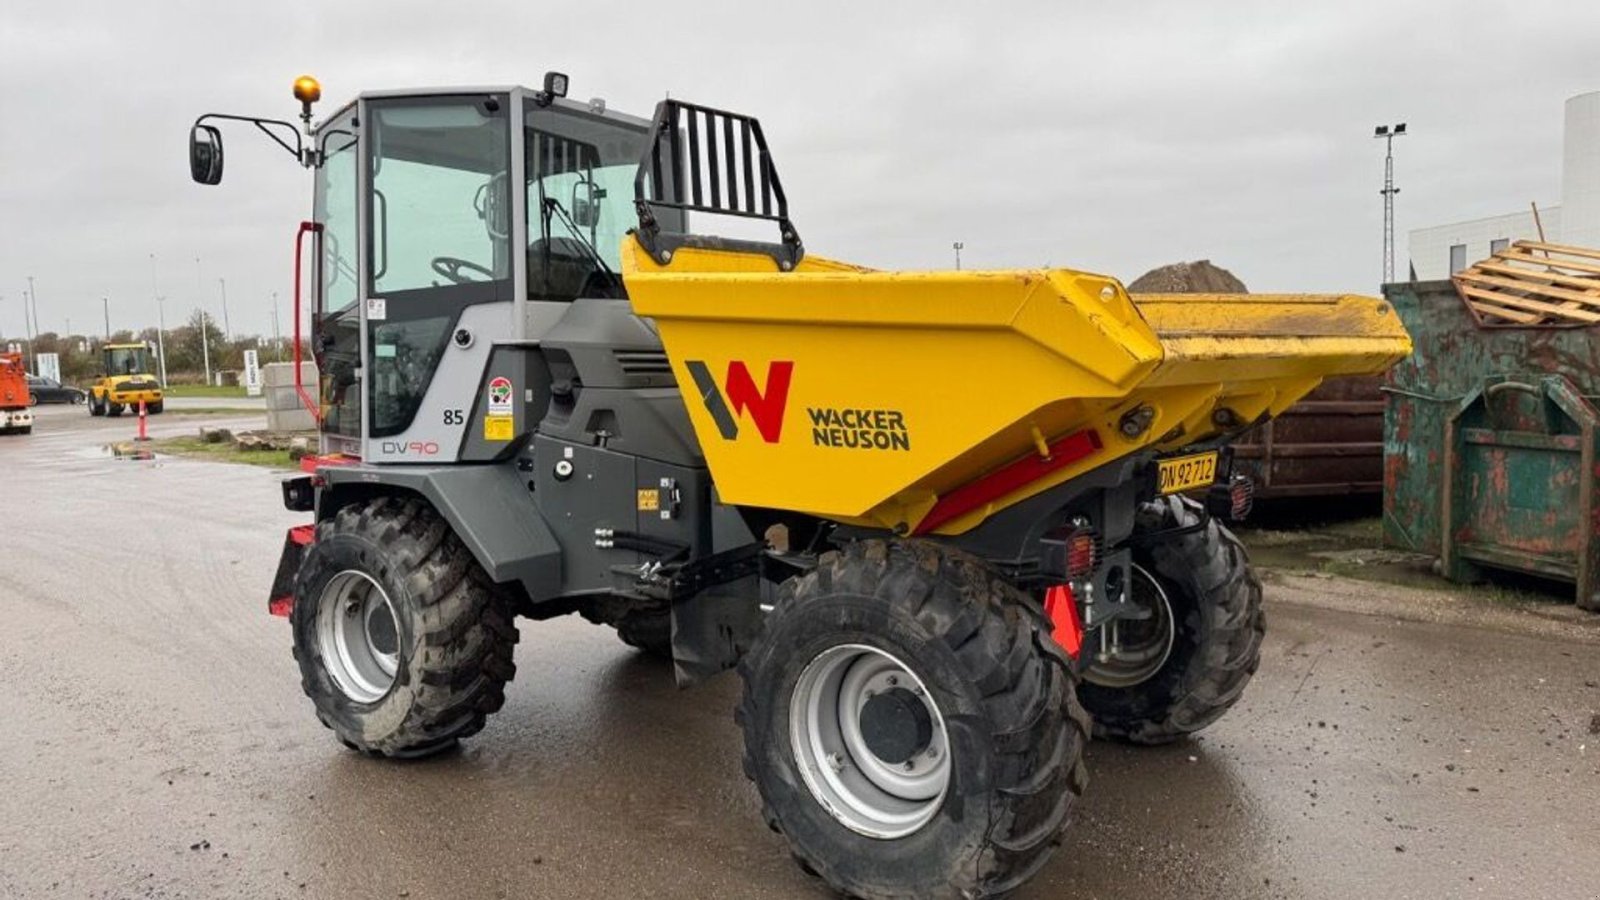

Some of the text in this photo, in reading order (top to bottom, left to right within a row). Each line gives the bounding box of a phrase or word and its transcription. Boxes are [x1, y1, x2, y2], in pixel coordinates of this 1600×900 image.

[443, 410, 464, 425] 85
[807, 408, 907, 430] WACKER
[382, 441, 439, 455] DV90
[812, 427, 910, 451] NEUSON
